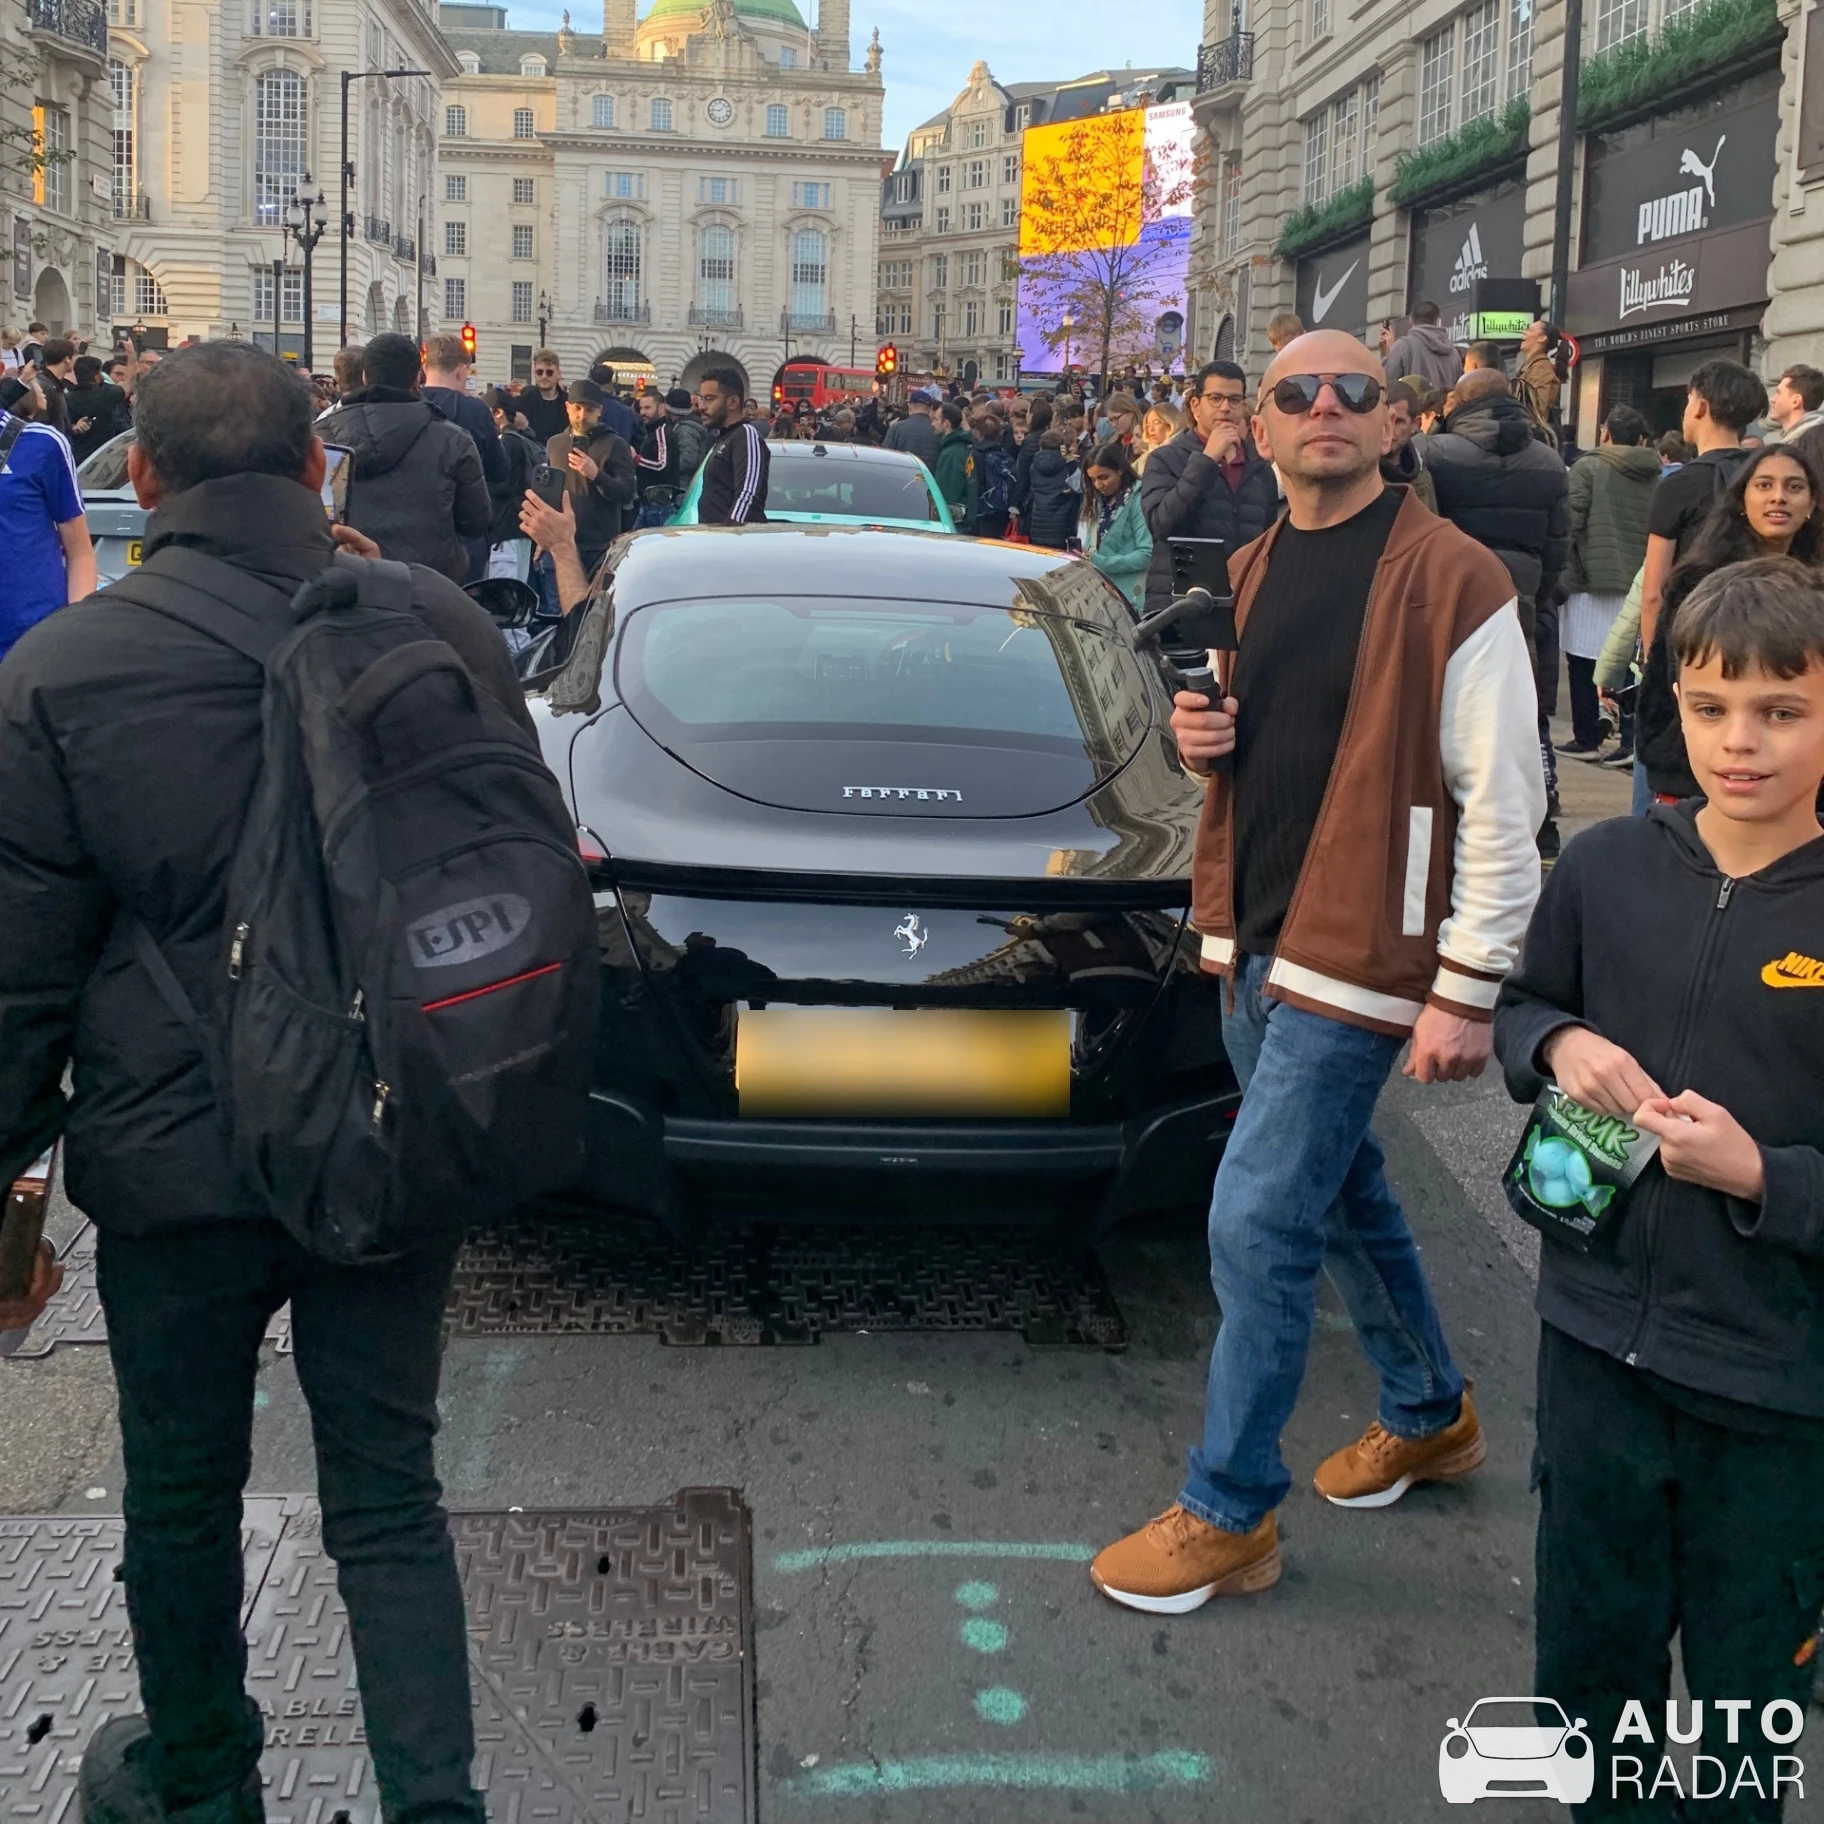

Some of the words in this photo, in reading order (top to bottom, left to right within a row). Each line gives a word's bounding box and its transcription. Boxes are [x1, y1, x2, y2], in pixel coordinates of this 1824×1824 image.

[1148, 107, 1187, 121] SAMSUNG
[1637, 186, 1704, 245] PUMA
[1449, 264, 1488, 294] adidas
[1619, 259, 1695, 320] Lillywhites
[1594, 337, 1607, 349] THE
[1610, 331, 1638, 346] WORLD'S
[1640, 326, 1668, 341] FINEST
[1670, 320, 1699, 335] SPORTS
[1703, 314, 1729, 329] STORE
[842, 785, 964, 802] Ferrari
[546, 1615, 736, 1639] WIRELESS
[608, 1641, 735, 1663] CABLE
